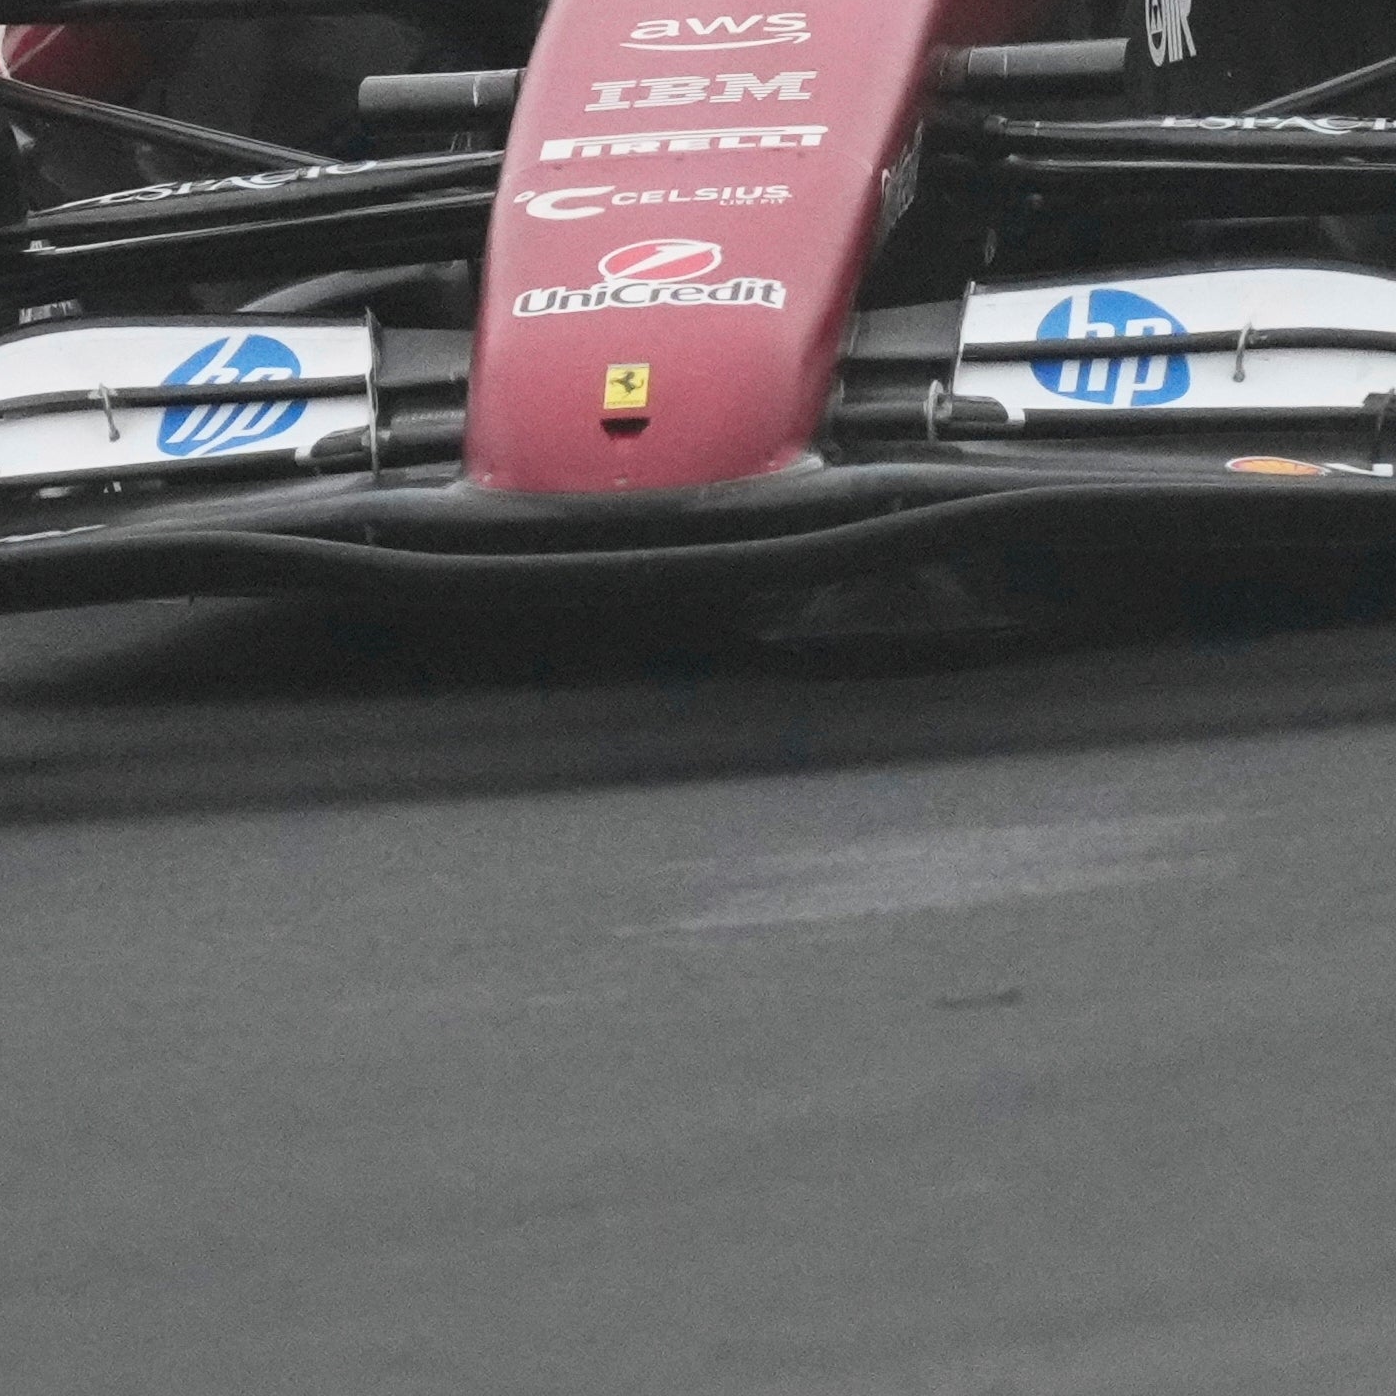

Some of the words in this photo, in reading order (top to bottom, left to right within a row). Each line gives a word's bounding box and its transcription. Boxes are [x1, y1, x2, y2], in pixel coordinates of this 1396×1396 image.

[628, 12, 808, 41] aws
[584, 71, 817, 112] IBM
[539, 125, 829, 161] PIRELLI
[612, 185, 791, 205] CELSIUS
[517, 279, 782, 314] UniCredit
[1049, 289, 1179, 406] hp
[160, 334, 299, 456] hp
